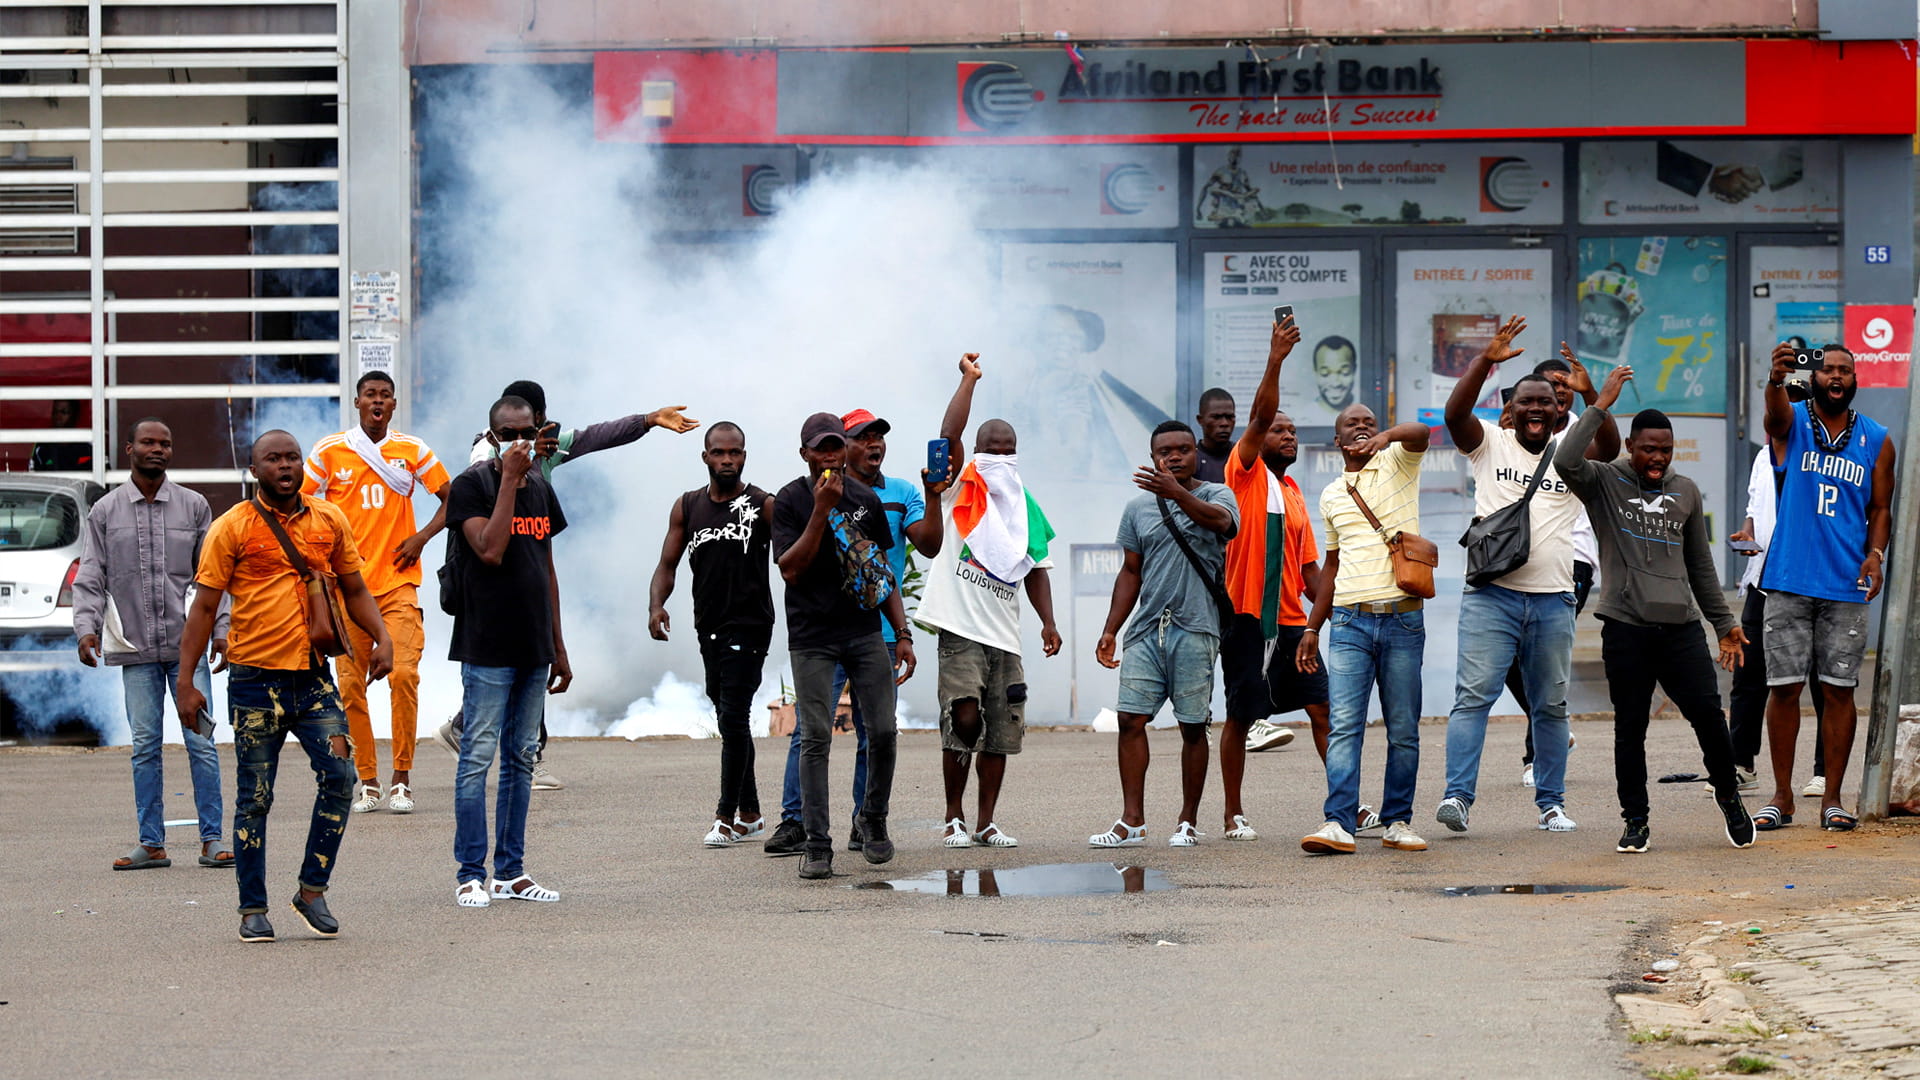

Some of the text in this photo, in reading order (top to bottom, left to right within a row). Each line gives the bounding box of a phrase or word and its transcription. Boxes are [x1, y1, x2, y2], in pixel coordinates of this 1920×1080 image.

[1058, 57, 1443, 97] Afriland First Bank
[1188, 102, 1437, 131] The pact with Success
[1270, 160, 1447, 174] Une relation de confiance
[1249, 255, 1310, 268] AVEC OU
[1867, 246, 1888, 263] 55
[1249, 270, 1286, 283] SANS
[1289, 270, 1348, 283] COMPTE
[1413, 266, 1465, 281] ENTRÉE
[1485, 268, 1535, 281] SORTIE
[1760, 268, 1802, 280] ENTRÉE
[1818, 269, 1842, 280] SOR
[1659, 313, 1717, 331] Taux de
[1496, 467, 1572, 495] HILFGE
[360, 483, 385, 509] 10
[1817, 483, 1839, 517] 12
[511, 516, 551, 540] range
